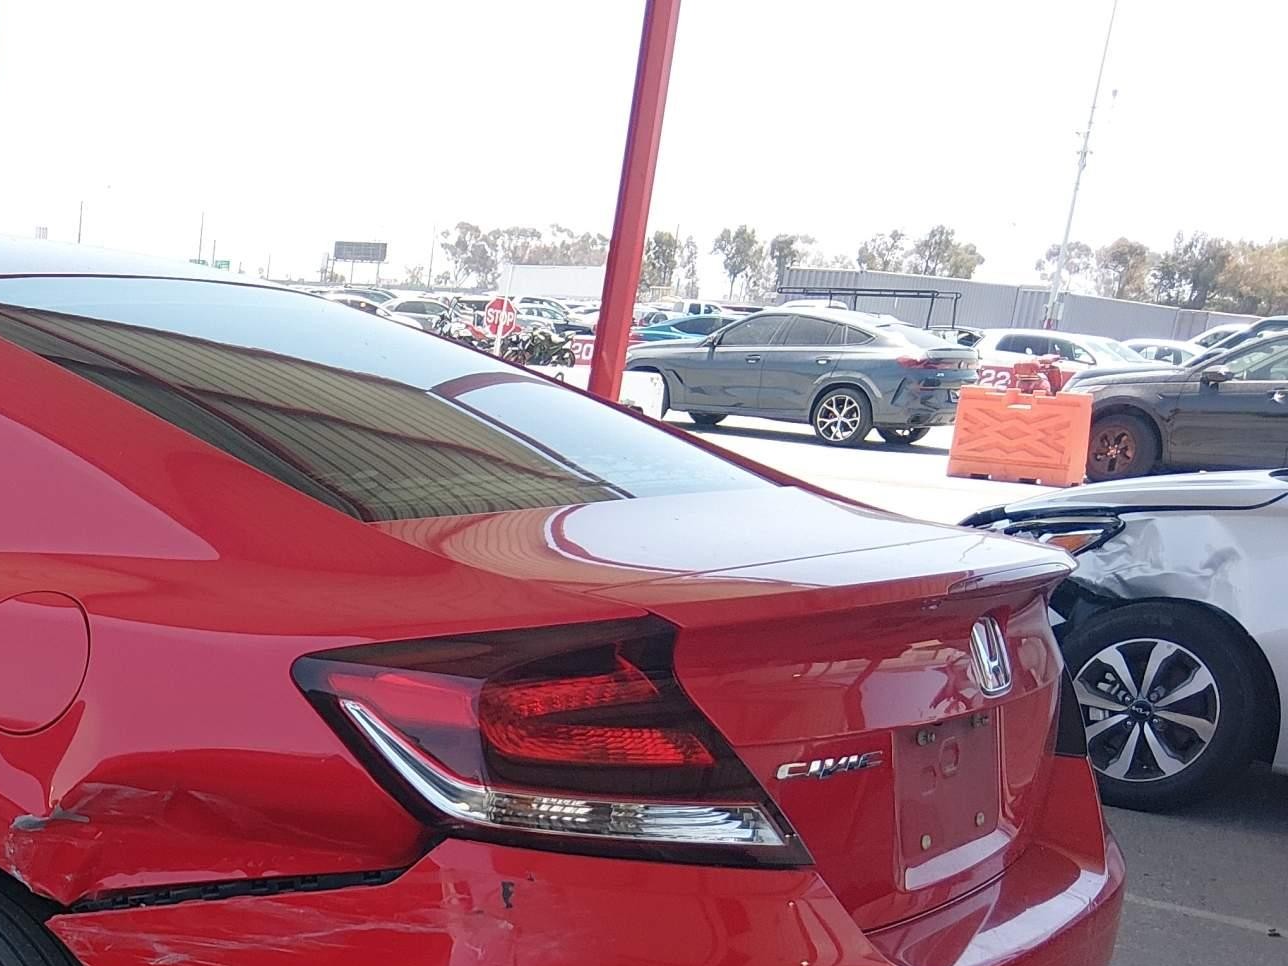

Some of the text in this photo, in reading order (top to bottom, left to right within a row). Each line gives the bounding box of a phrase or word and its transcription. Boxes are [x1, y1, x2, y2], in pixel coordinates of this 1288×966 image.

[486, 308, 514, 326] STOP
[979, 369, 1011, 390] 22
[776, 750, 883, 780] CIVIC
